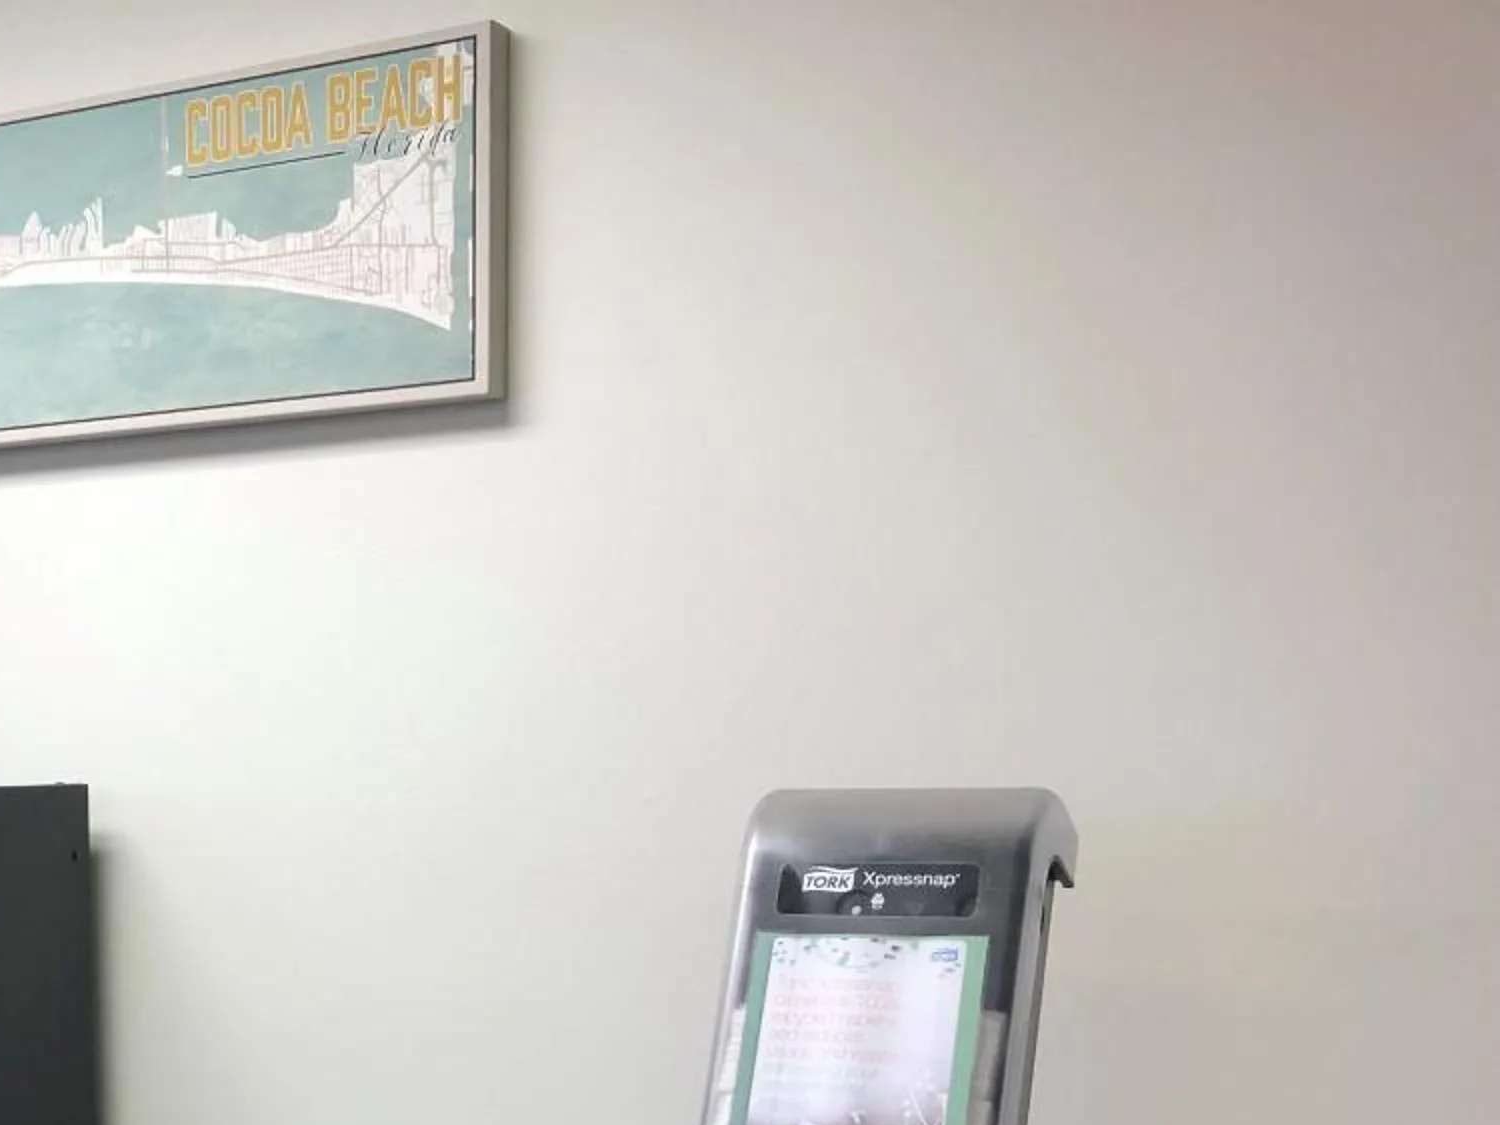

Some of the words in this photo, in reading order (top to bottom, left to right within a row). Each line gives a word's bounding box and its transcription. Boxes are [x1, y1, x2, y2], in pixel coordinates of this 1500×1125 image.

[185, 81, 313, 168] COCOA
[326, 54, 463, 145] BEACH
[357, 119, 460, 161] Florida
[805, 875, 851, 889] TORK
[862, 871, 957, 888] Xpressnap
